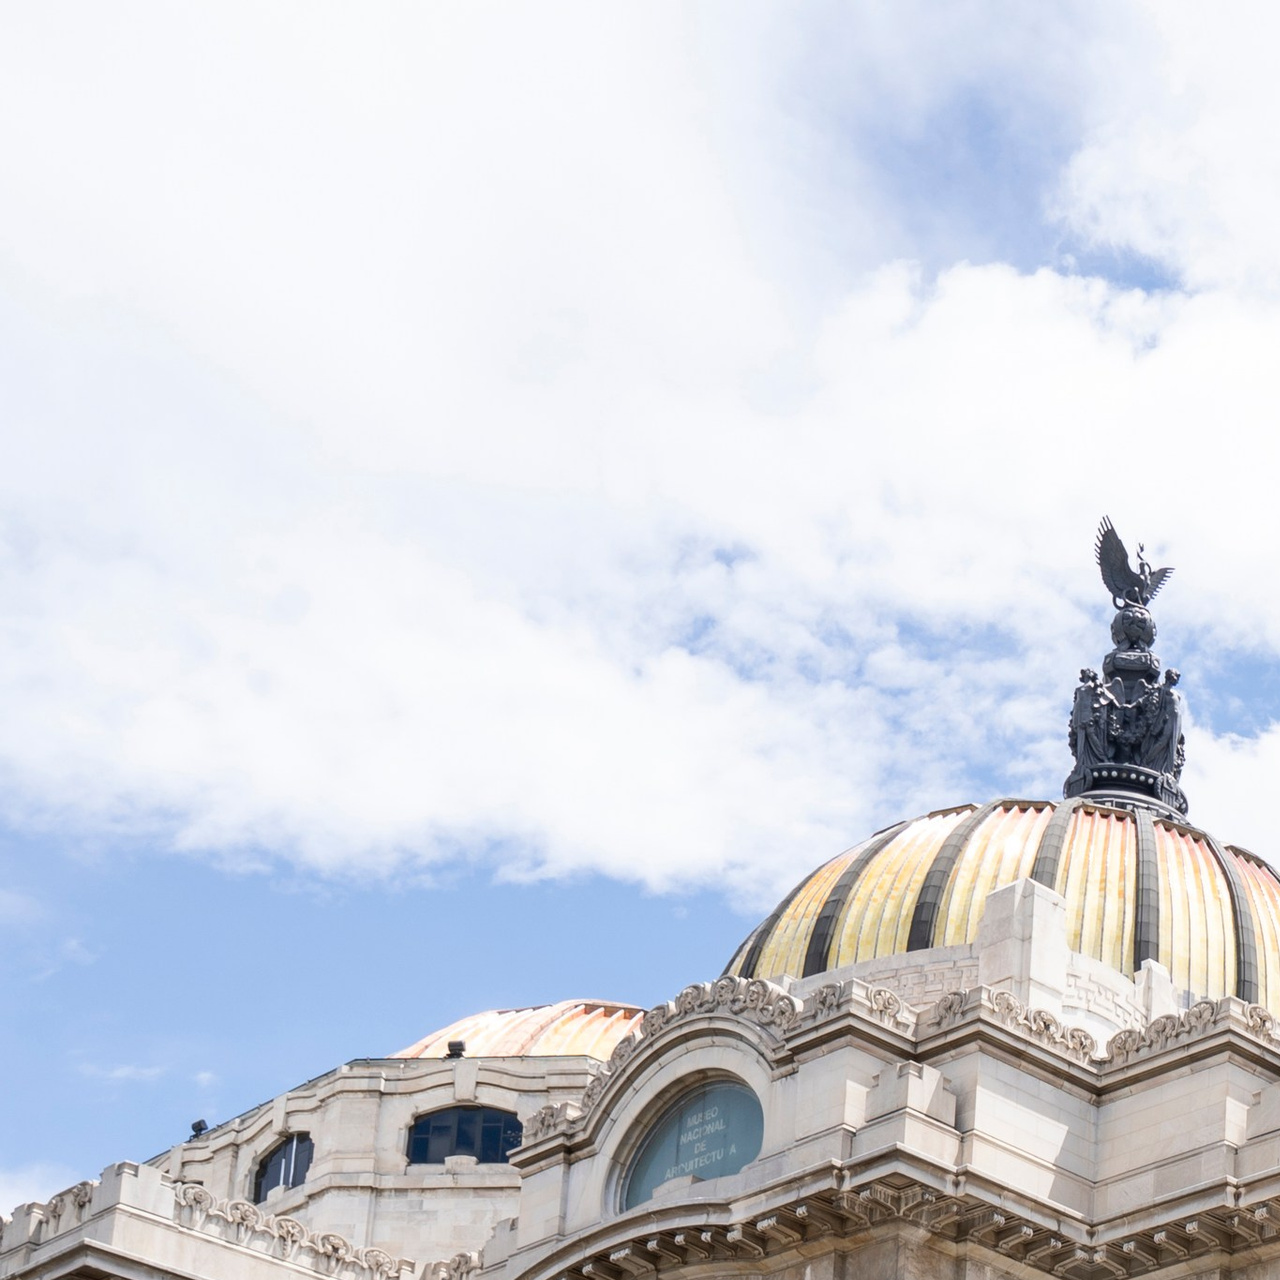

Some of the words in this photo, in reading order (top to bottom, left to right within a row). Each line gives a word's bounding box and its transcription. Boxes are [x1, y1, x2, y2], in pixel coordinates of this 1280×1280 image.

[680, 1118, 726, 1145] NACIONAL
[694, 1139, 707, 1154] DE
[664, 1143, 737, 1180] ARUITECTUA
